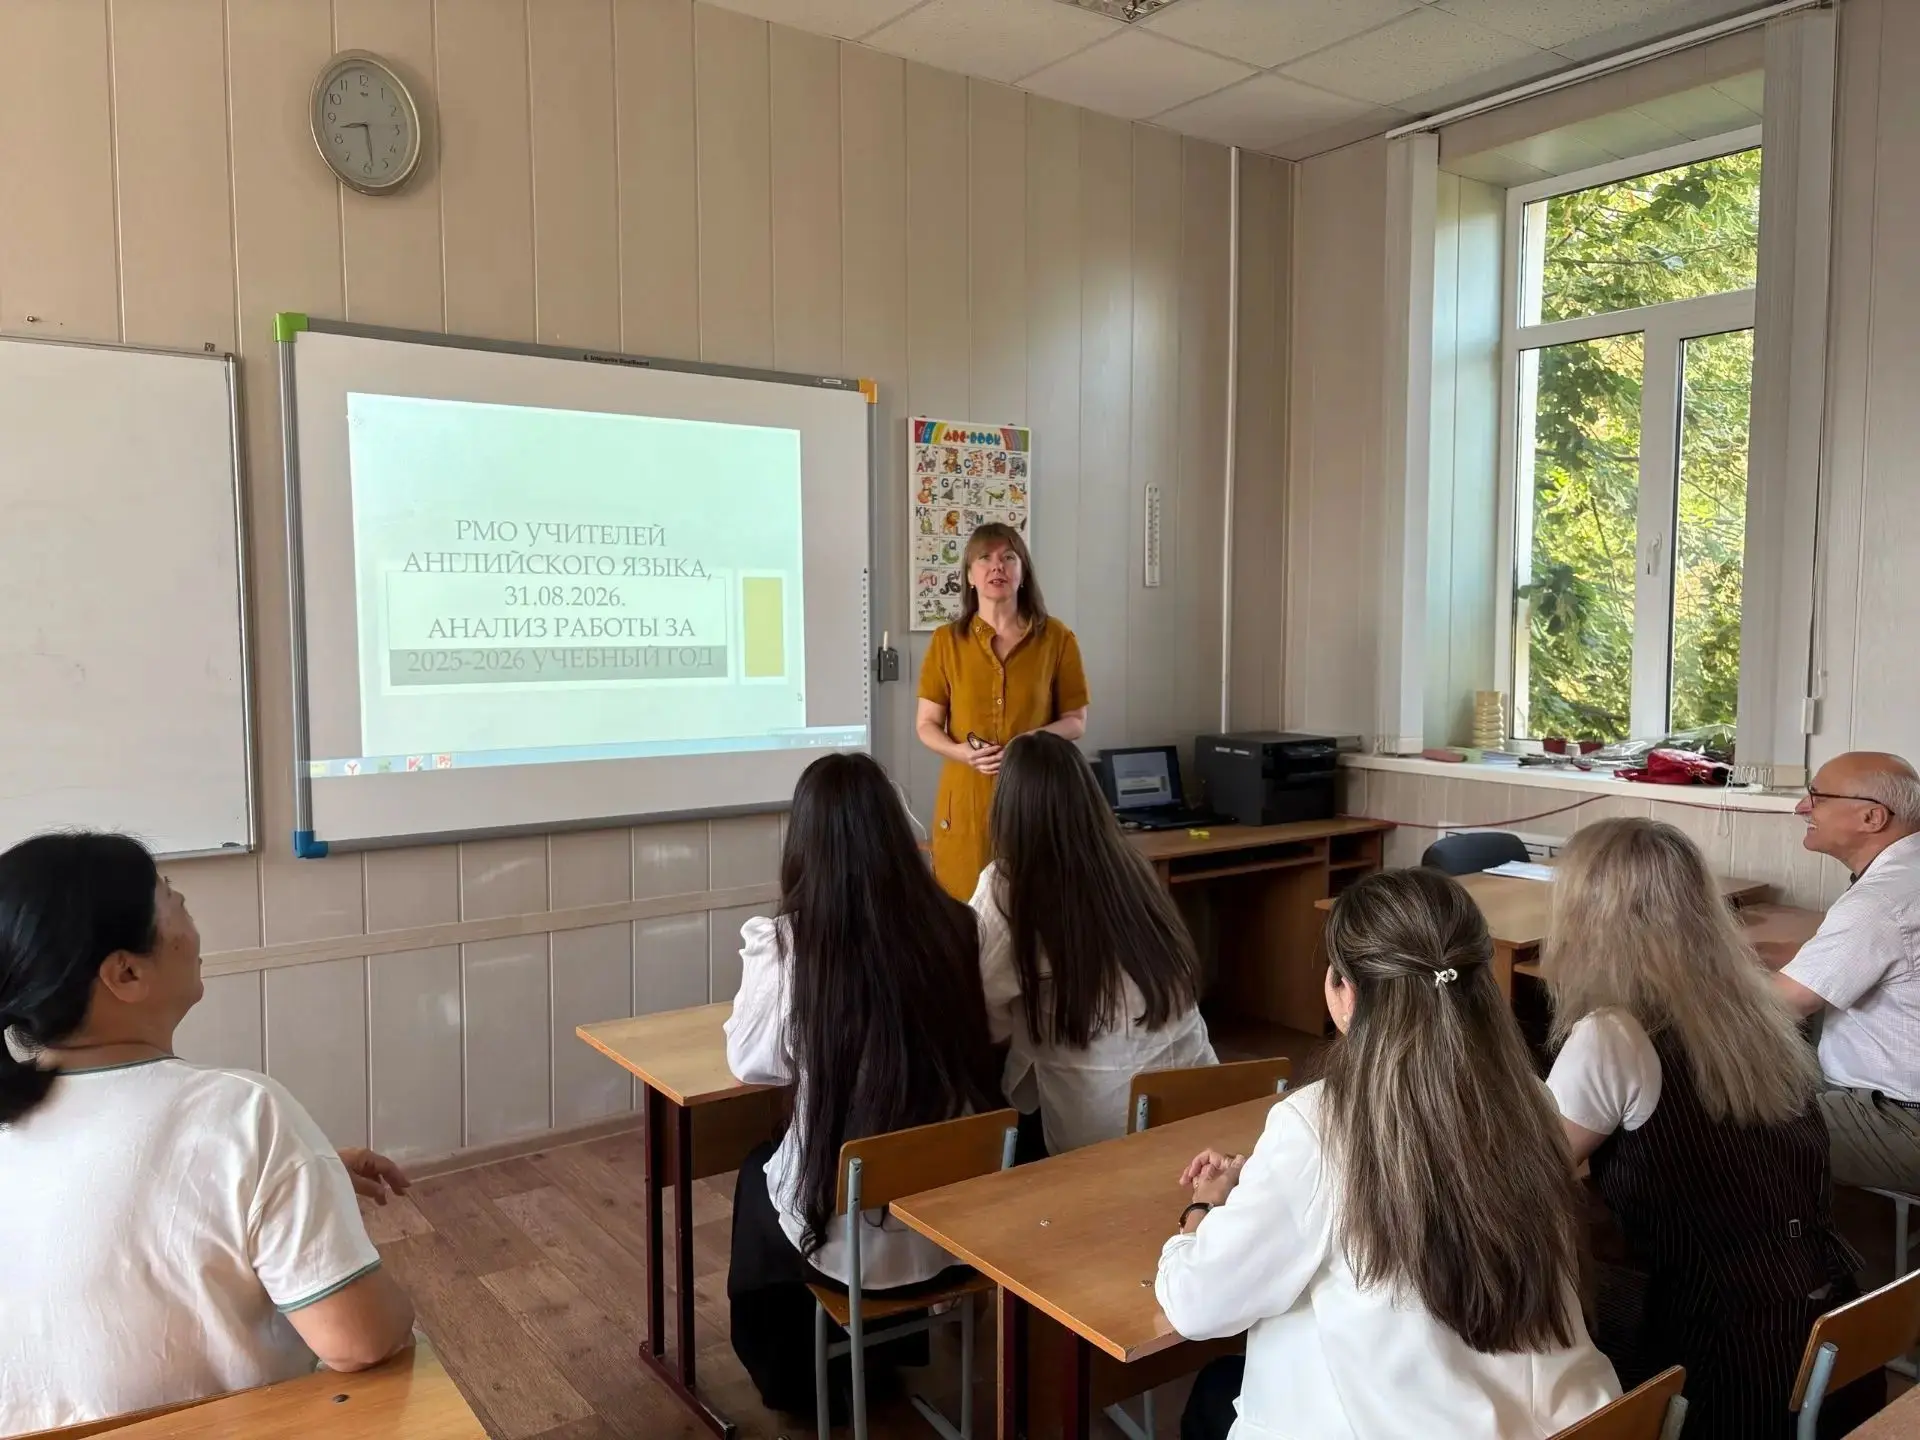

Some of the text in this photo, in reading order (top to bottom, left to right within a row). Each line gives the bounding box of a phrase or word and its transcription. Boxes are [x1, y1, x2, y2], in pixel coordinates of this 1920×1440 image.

[341, 80, 347, 92] 11
[360, 75, 368, 87] 12
[330, 93, 341, 105] 10
[328, 112, 336, 123] 9
[335, 134, 343, 144] 8
[1000, 452, 1006, 461] D
[916, 463, 924, 472] A
[964, 459, 971, 468] C
[955, 464, 962, 474] B
[941, 478, 948, 488] G
[963, 479, 970, 489] H
[931, 494, 937, 504] F
[976, 514, 984, 524] M
[456, 519, 667, 548] РМО УЧИТЕЛЕЙ
[949, 540, 956, 550] Q
[931, 554, 938, 564] P
[402, 550, 713, 582] АНГЛИЙСКОГО ЯЗЫКА,
[930, 575, 937, 586] U
[504, 585, 626, 607] 31.08.2026.
[427, 617, 697, 639] АНАЛИЗ РАБОТЫ ЗА
[406, 644, 715, 674] 2025-2026 УЧЕБНЫЙ ГОД
